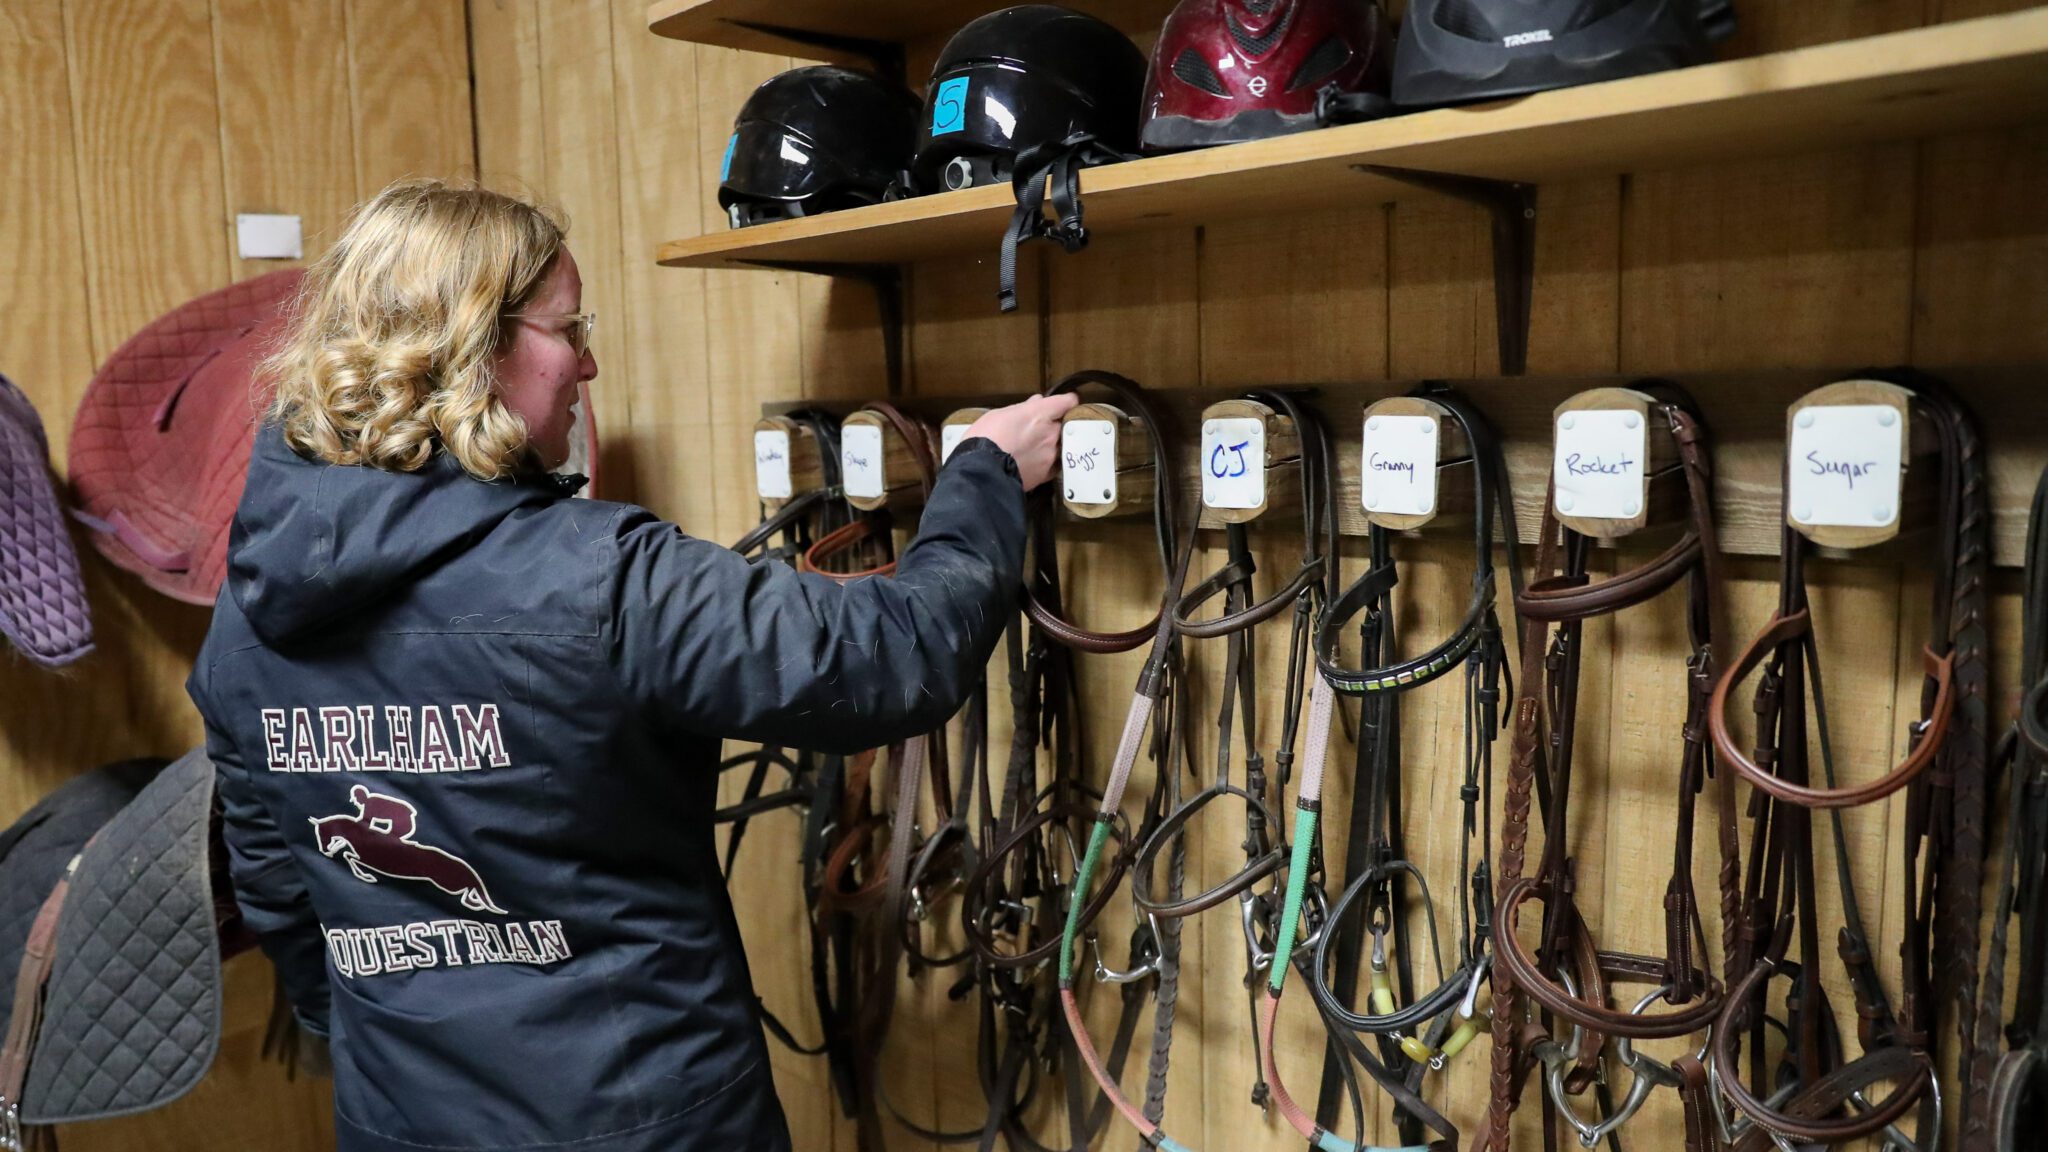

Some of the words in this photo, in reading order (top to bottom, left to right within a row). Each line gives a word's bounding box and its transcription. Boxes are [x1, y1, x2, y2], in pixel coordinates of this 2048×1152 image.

[1503, 29, 1553, 48] TROXEL
[1065, 447, 1100, 472] Biggie
[1211, 440, 1249, 479] CJ
[1565, 452, 1634, 476] Rocket
[1806, 450, 1878, 490] Sugar
[261, 703, 512, 774] EARLHAM
[320, 919, 573, 979] QUESTRIAN
